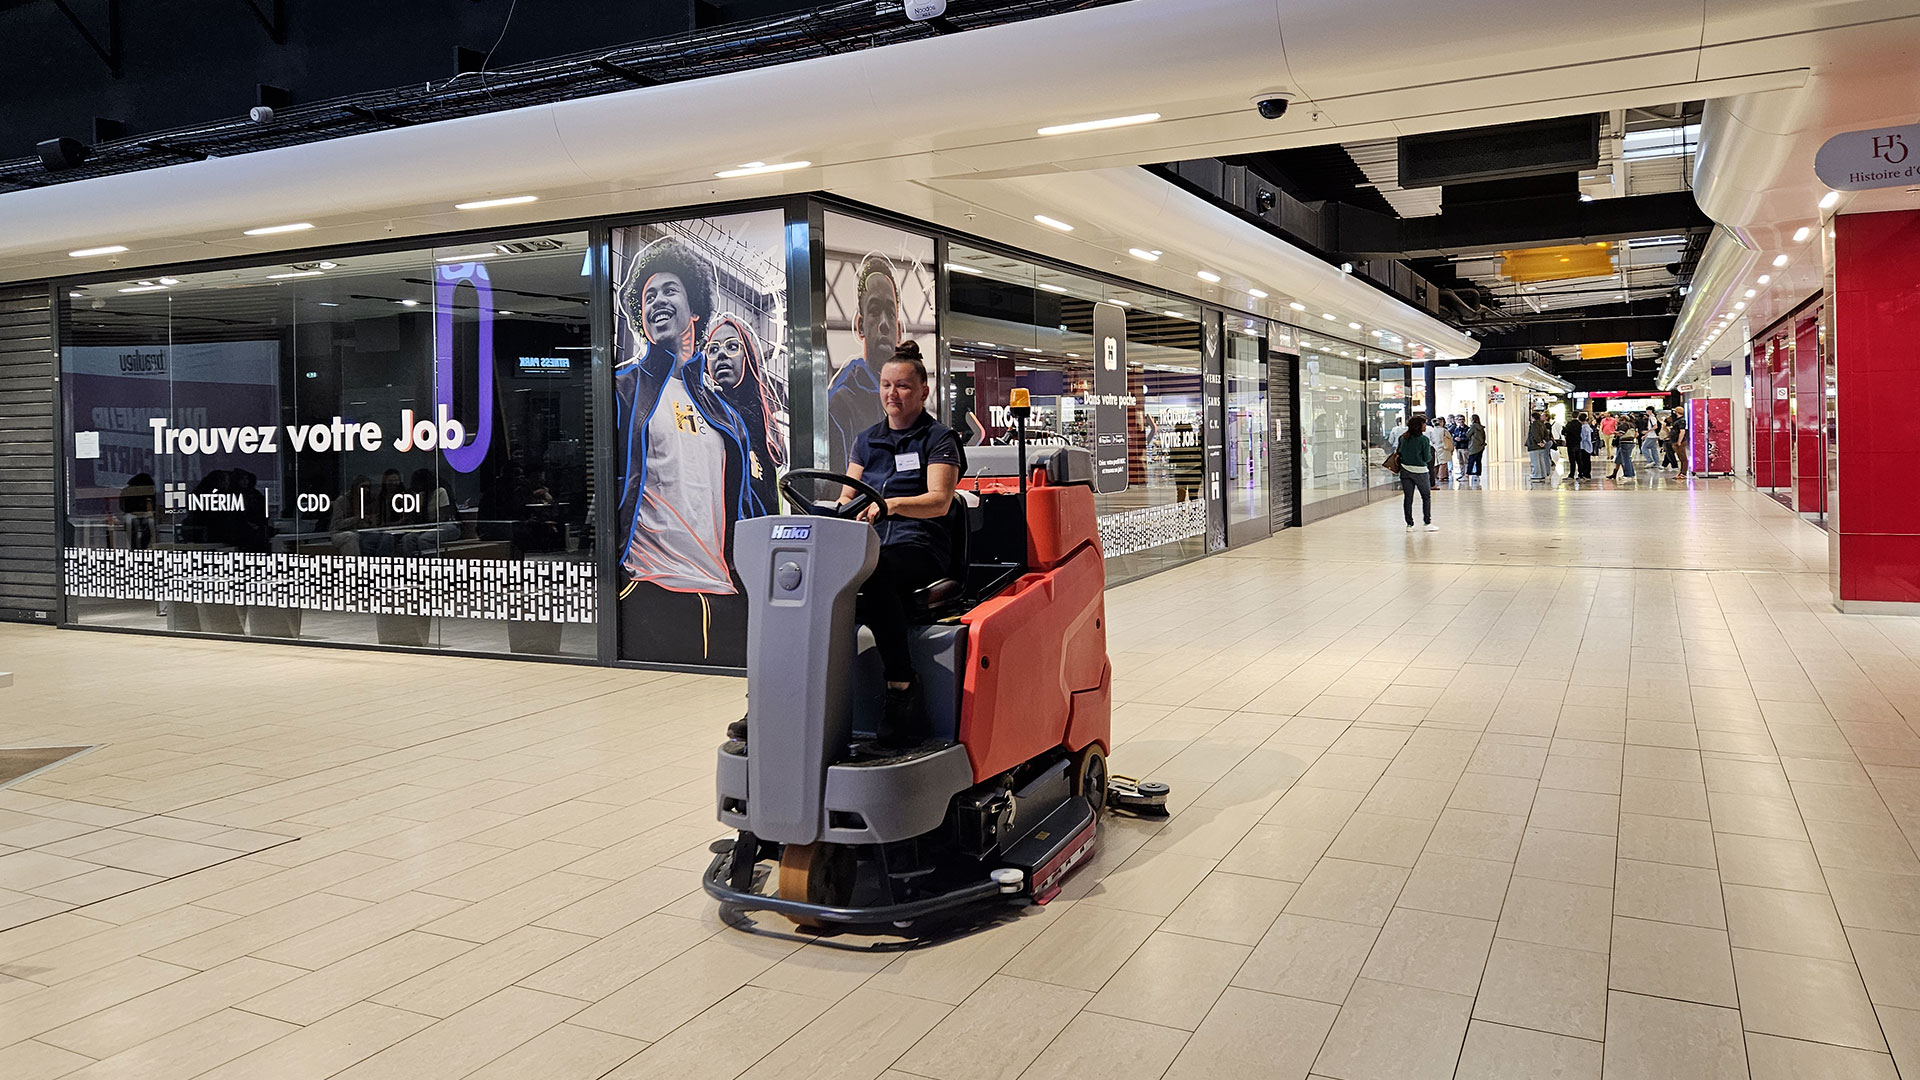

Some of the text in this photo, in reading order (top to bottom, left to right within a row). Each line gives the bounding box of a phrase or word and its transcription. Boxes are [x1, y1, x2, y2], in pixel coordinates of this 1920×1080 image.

[1849, 166, 1920, 183] Histoire d'
[1083, 391, 1137, 409] Dans votre poche
[1207, 396, 1221, 407] SANS
[149, 403, 465, 455] Trouvez votre Job
[1159, 431, 1181, 449] VOTRE
[188, 488, 420, 513] INTÉRIM CDD CDI
[771, 524, 812, 540] Hako
